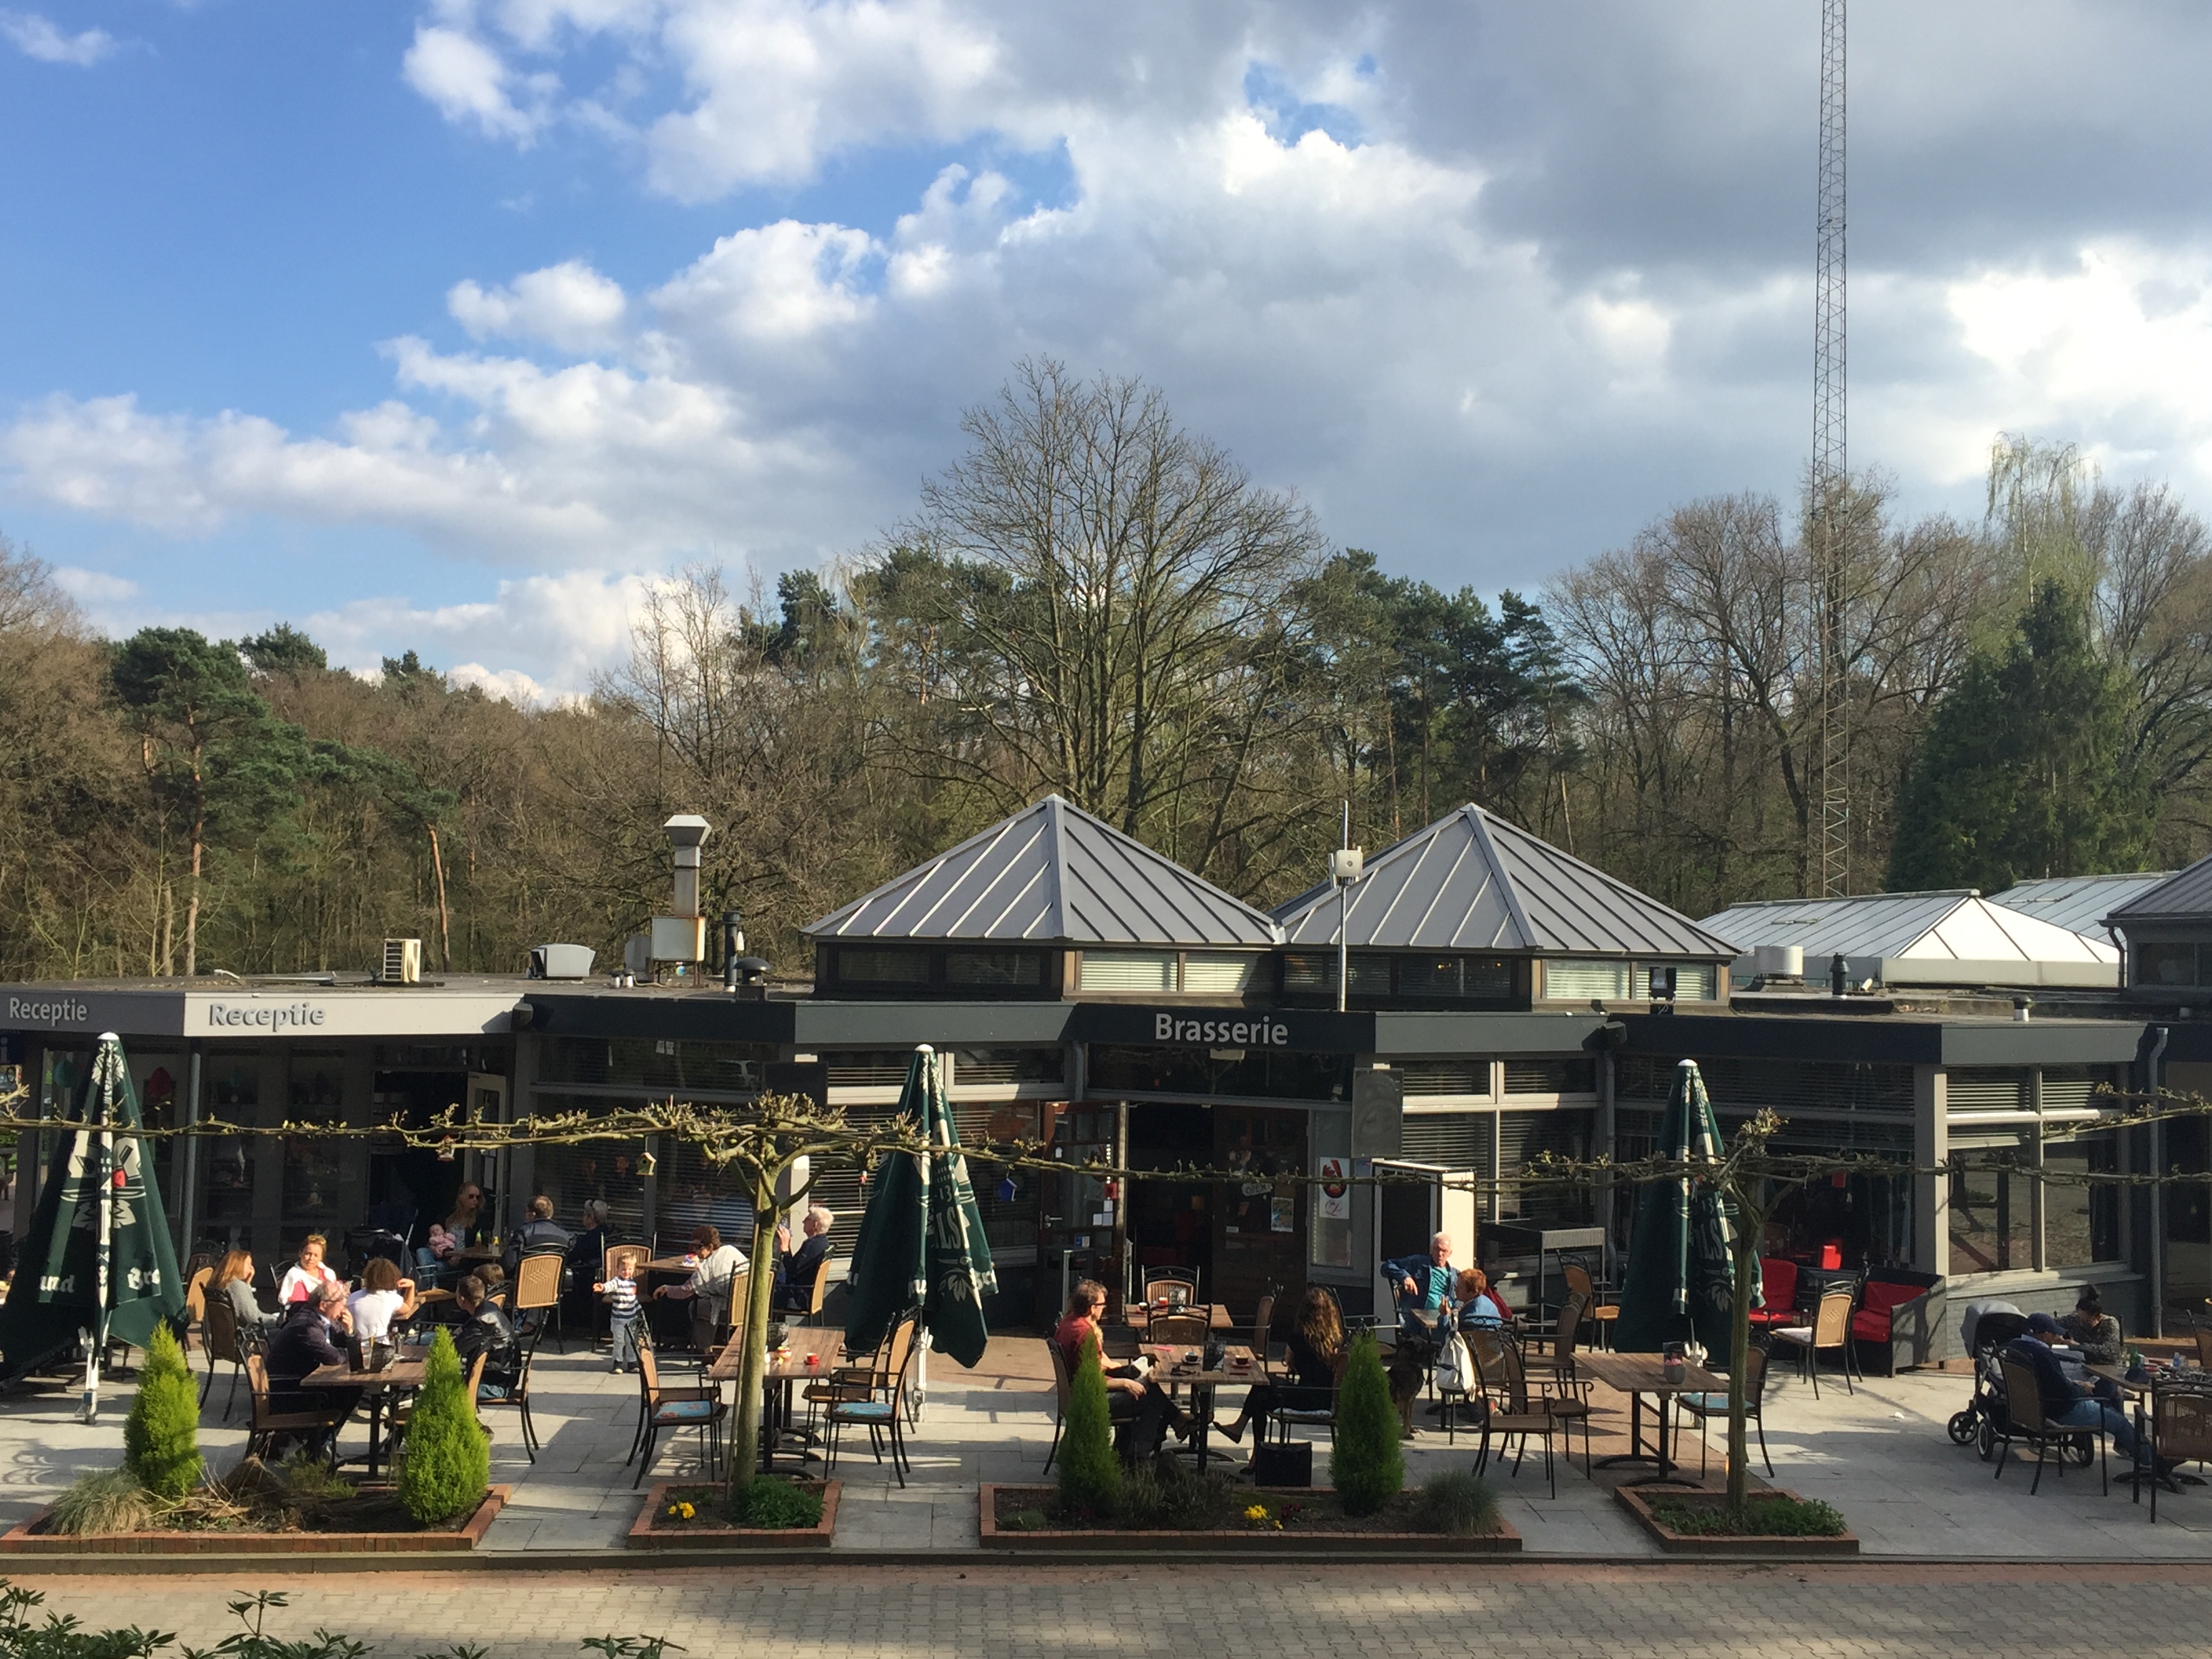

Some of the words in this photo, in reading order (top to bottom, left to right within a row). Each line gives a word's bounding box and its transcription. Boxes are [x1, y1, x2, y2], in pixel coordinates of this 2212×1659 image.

[9, 997, 87, 1027] Receptie
[209, 1002, 326, 1032] Receptie
[1155, 1013, 1288, 1045] Brasserie
